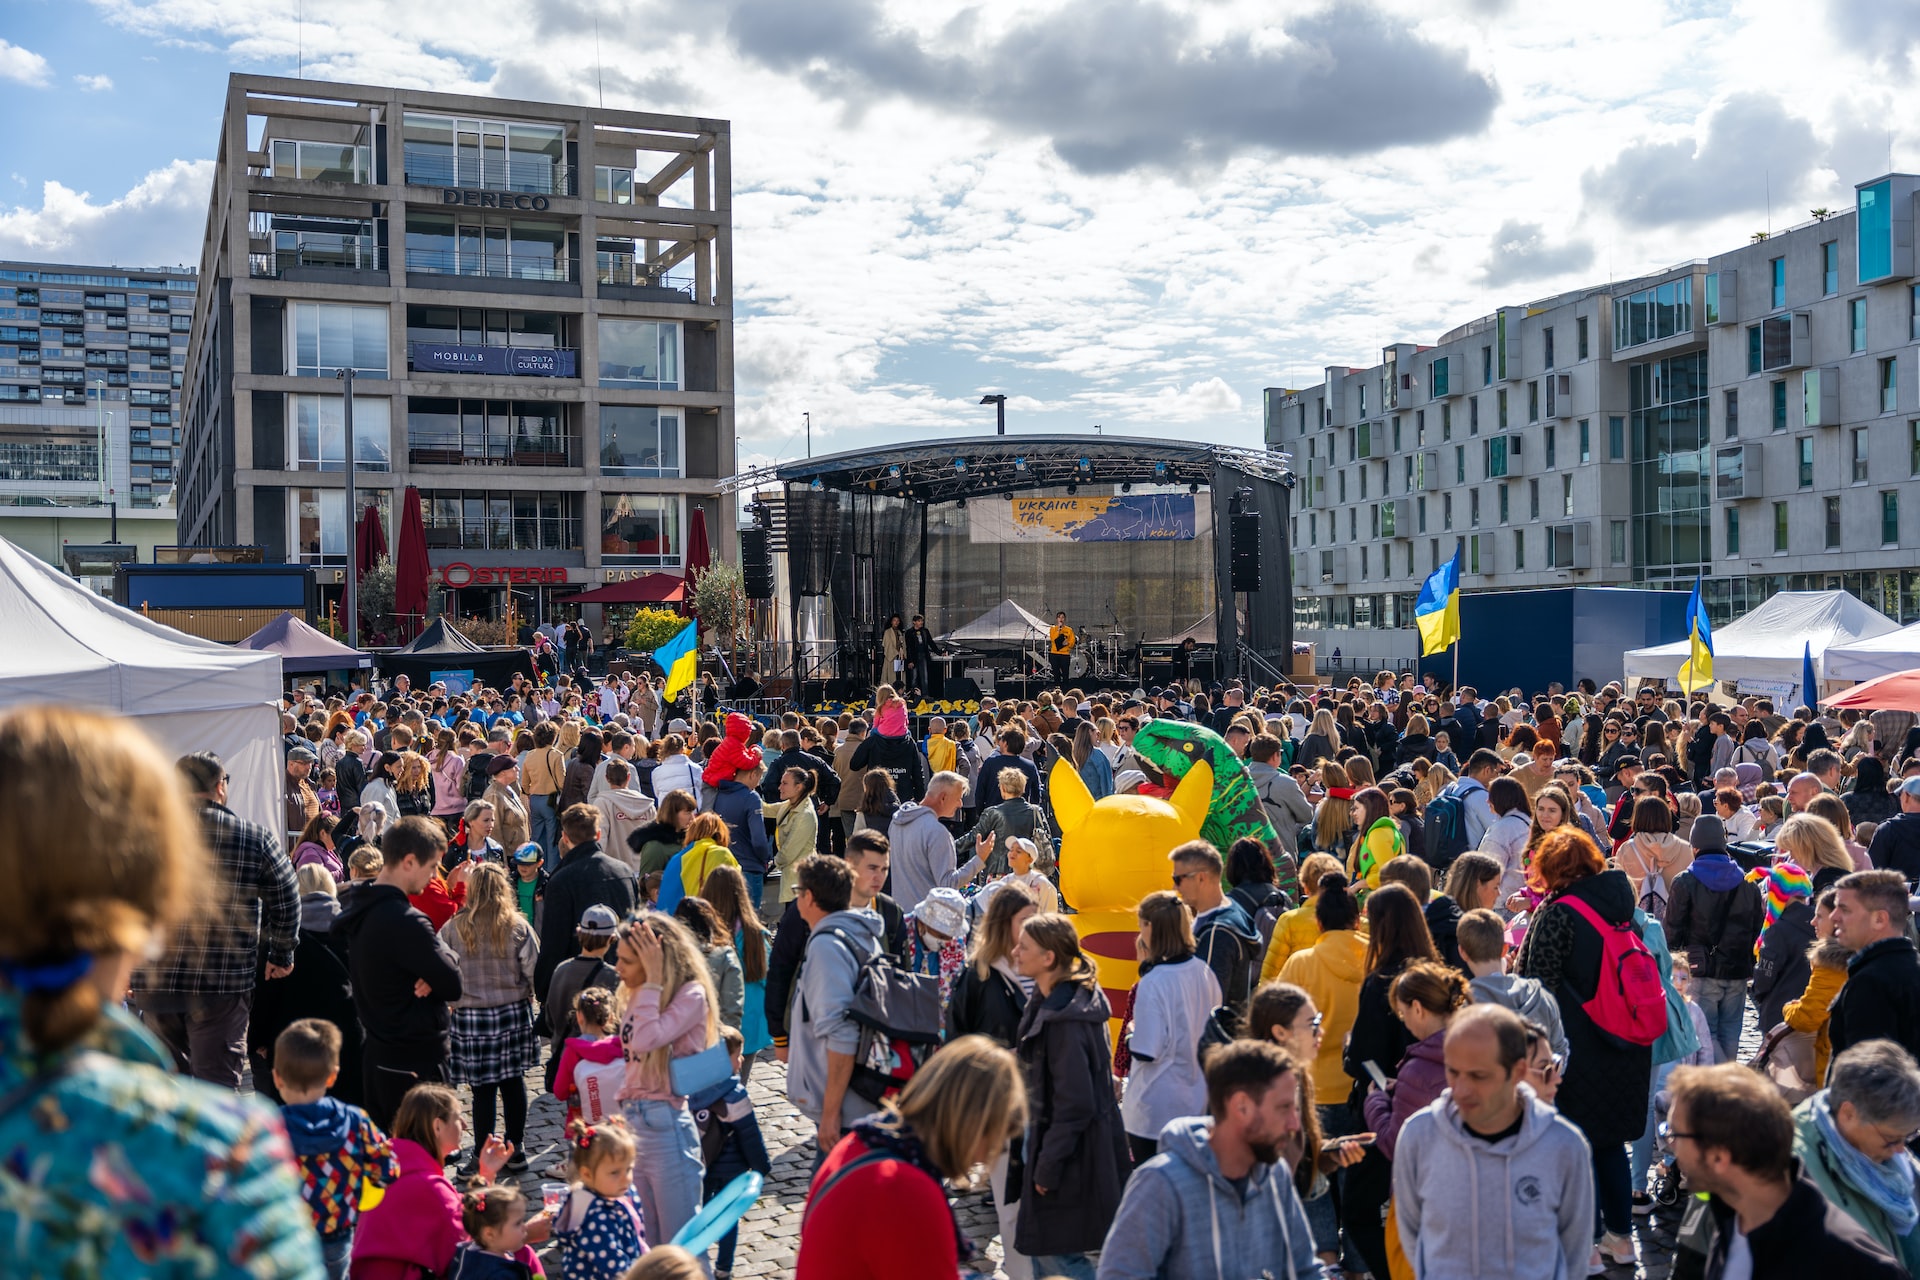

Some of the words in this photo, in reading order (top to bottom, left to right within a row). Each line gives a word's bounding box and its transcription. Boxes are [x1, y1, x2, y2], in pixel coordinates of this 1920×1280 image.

[444, 190, 549, 211] DERECO
[433, 352, 483, 361] MOBILAB
[518, 362, 554, 370] CULTURE
[1018, 500, 1078, 511] UKRAINE
[1019, 512, 1044, 525] TAG
[1150, 528, 1178, 537] KÖLN
[606, 569, 662, 583] PAST
